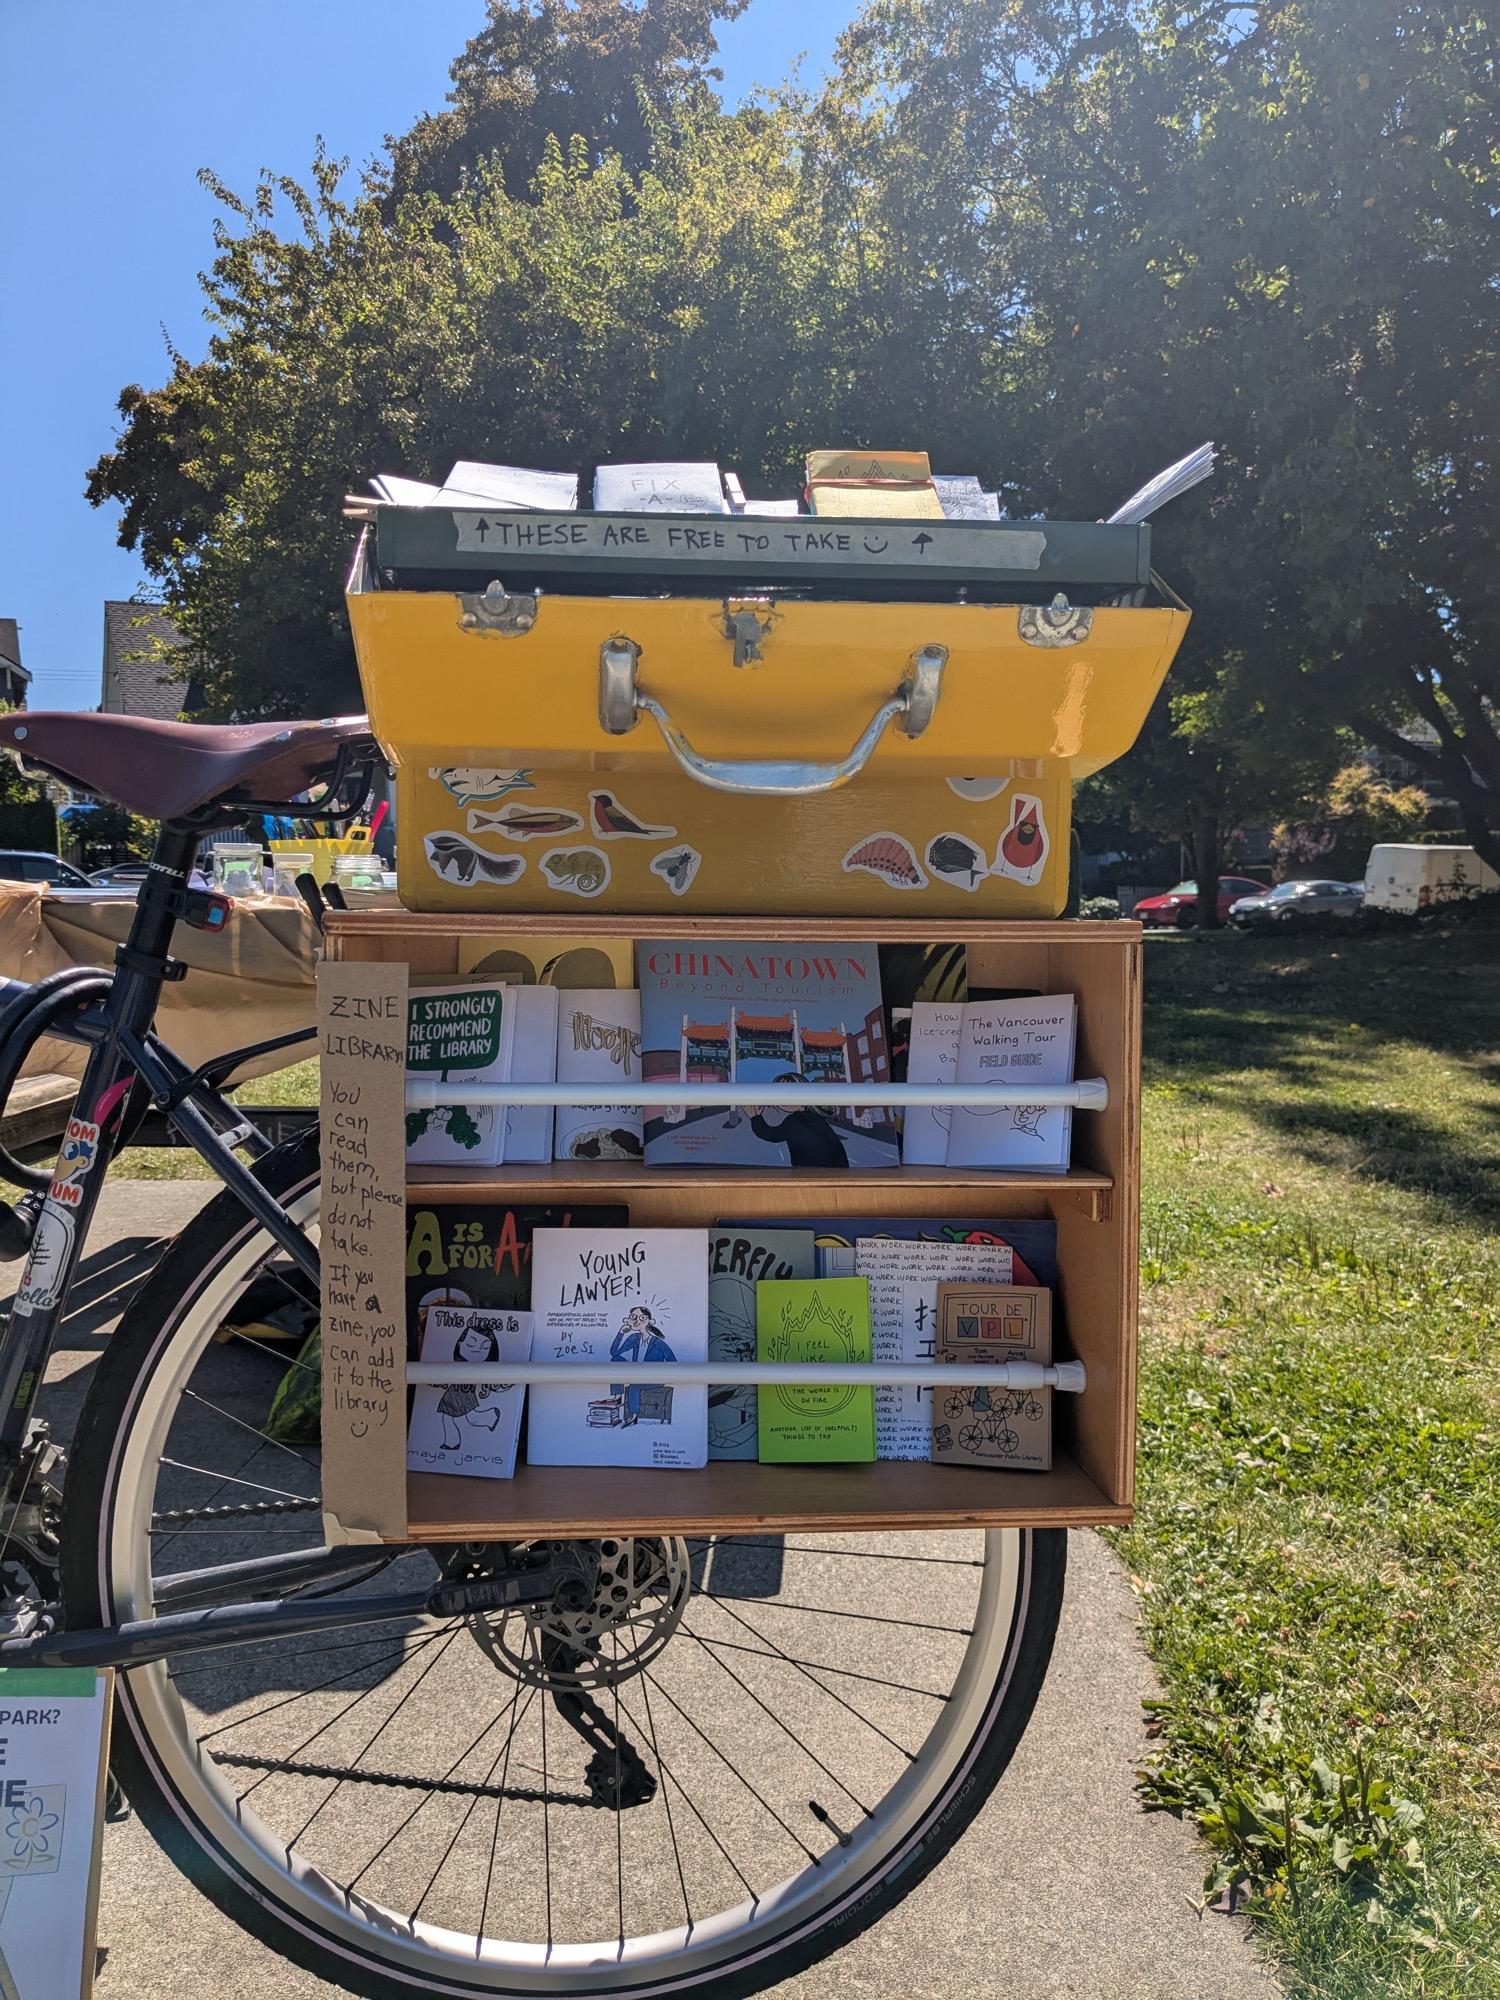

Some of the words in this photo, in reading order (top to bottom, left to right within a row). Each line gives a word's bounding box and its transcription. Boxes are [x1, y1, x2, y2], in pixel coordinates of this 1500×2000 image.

[631, 478, 680, 492] FIX
[496, 522, 588, 547] THESE
[602, 524, 650, 547] ARE
[668, 526, 725, 550] FREE
[737, 533, 770, 553] TO
[784, 532, 851, 552] TAKE
[648, 952, 869, 982] CHINATOWN
[659, 977, 744, 993] Beyond
[762, 983, 854, 996] Tourism
[328, 995, 401, 1020] ZINE
[411, 1003, 417, 1021] I
[424, 996, 497, 1020] STRONGLY
[934, 1012, 959, 1023] How
[409, 1018, 493, 1042] RECOMMEND
[968, 1018, 993, 1031] The
[997, 1015, 1066, 1028] Vancouver
[407, 1043, 432, 1062] THE
[439, 1037, 493, 1060] LIBRARY
[972, 1035, 1019, 1048] Walking
[1024, 1031, 1057, 1043] Tour
[979, 1054, 1009, 1068] FIELD
[1010, 1052, 1043, 1067] GUIDE
[334, 1112, 369, 1134] can
[329, 1131, 368, 1159] read
[329, 1150, 379, 1182] them,
[330, 1175, 357, 1196] but
[360, 1187, 404, 1211] please
[327, 1202, 346, 1226] do
[350, 1211, 376, 1230] not
[330, 1230, 374, 1258] take.
[452, 1222, 484, 1243] IS
[448, 1243, 494, 1269] FOR
[579, 1240, 647, 1280] YOUNG
[328, 1263, 351, 1288] If
[354, 1269, 375, 1293] you
[560, 1266, 642, 1307] LAWYER!
[328, 1283, 358, 1311] have
[956, 1302, 999, 1317] TOUR
[1005, 1303, 1024, 1317] DE
[434, 1310, 465, 1329] This
[466, 1311, 503, 1332] dress
[506, 1315, 520, 1333] is
[371, 1324, 396, 1347] you
[560, 1330, 573, 1343] BY
[329, 1345, 359, 1363] can
[367, 1349, 395, 1369] add
[333, 1367, 344, 1385] it
[350, 1367, 364, 1386] to
[367, 1370, 394, 1393] the
[333, 1389, 389, 1426] library
[407, 1449, 446, 1464] maya
[454, 1451, 504, 1465] jarvis
[0, 1708, 61, 1725] PARK?
[926, 1773, 977, 1845] SCHWALBE
